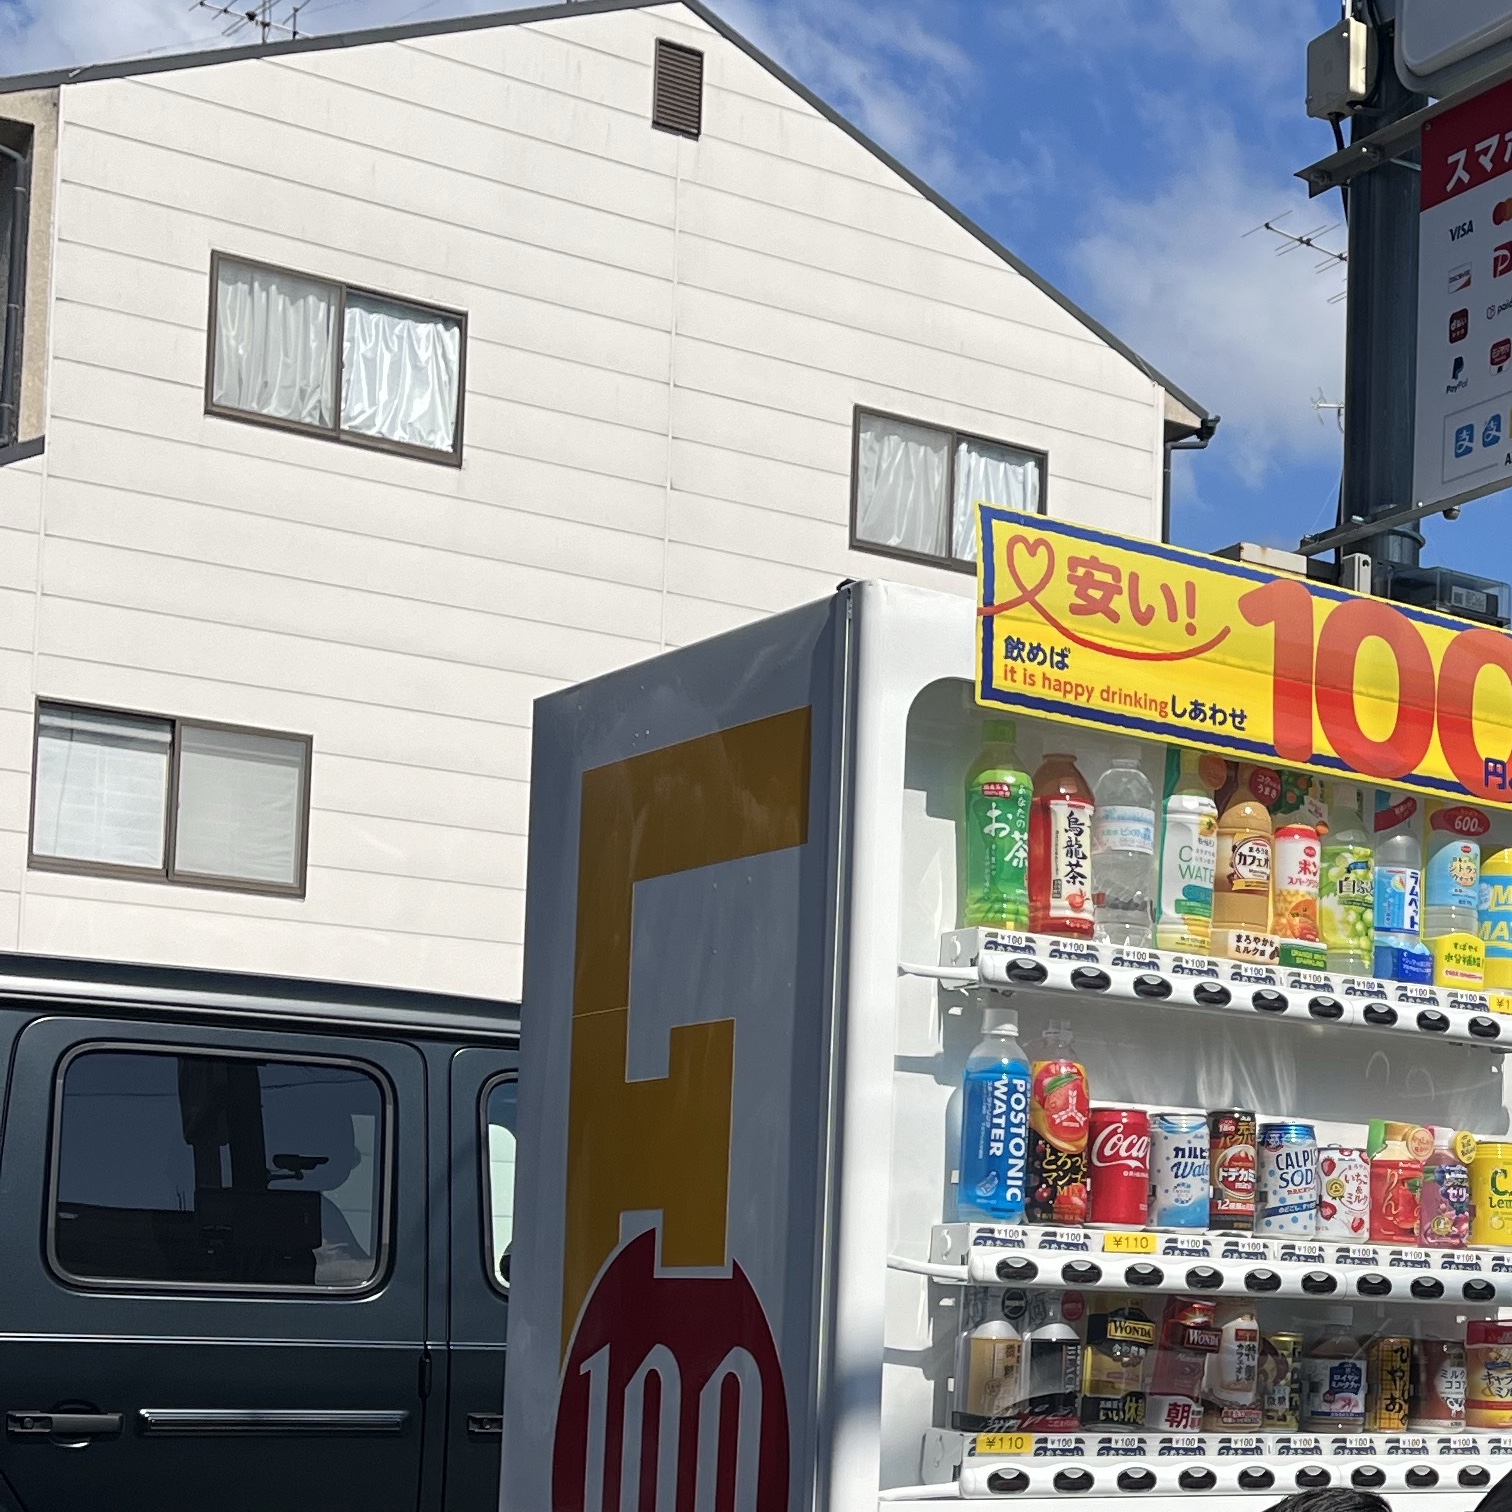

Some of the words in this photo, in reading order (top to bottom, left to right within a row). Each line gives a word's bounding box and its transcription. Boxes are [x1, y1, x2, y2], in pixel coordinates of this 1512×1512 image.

[1449, 220, 1474, 241] VISA
[1004, 636, 1071, 671] 飲めば
[1003, 664, 1021, 684] it
[1023, 668, 1036, 687] is
[1041, 673, 1095, 703] happy
[1099, 685, 1169, 718] drinking
[1170, 696, 1248, 731] しあわせ
[1178, 845, 1193, 863] C
[1297, 859, 1319, 876] ポン
[1178, 863, 1215, 884] WATE
[1000, 934, 1023, 946] ¥100
[1062, 941, 1085, 952] ¥100
[1126, 950, 1147, 960] ¥100
[1185, 958, 1206, 968] ¥100
[1243, 966, 1264, 976] ¥100
[1302, 973, 1322, 983] ¥100
[1356, 980, 1376, 990] ¥100
[1409, 987, 1428, 997] ¥100
[1459, 993, 1478, 1003] ¥100
[988, 1078, 1009, 1158] WATER
[1005, 1078, 1026, 1203] POSTONIC
[1091, 1123, 1151, 1170] Coca
[1042, 1150, 1087, 1173] とろっと
[1170, 1161, 1209, 1179] Wat
[1219, 1167, 1256, 1182] ドデカミ
[1278, 1168, 1315, 1189] SOD
[1447, 1187, 1469, 1202] ゼリ
[996, 1228, 1020, 1239] ¥100
[1059, 1232, 1081, 1242] ¥100
[1112, 1235, 1149, 1249] ¥110
[1179, 1239, 1201, 1248] ¥100
[1240, 1242, 1261, 1251] ¥100
[1297, 1245, 1317, 1254] ¥100
[1351, 1247, 1371, 1257] ¥100
[1403, 1250, 1422, 1260] ¥100
[1456, 1253, 1474, 1263] ¥100
[1110, 1320, 1152, 1339] WONDA
[1064, 1345, 1077, 1394] BLACK
[1165, 1401, 1192, 1430] 朝
[985, 1436, 1024, 1450] ¥110
[1050, 1437, 1072, 1448] ¥100
[1114, 1437, 1136, 1447] ¥100
[1175, 1437, 1196, 1447] ¥100
[1233, 1437, 1254, 1447] ¥100
[1292, 1437, 1312, 1447] ¥100
[1348, 1437, 1367, 1447] ¥100
[1402, 1437, 1420, 1447] ¥100
[1452, 1437, 1470, 1447] ¥100
